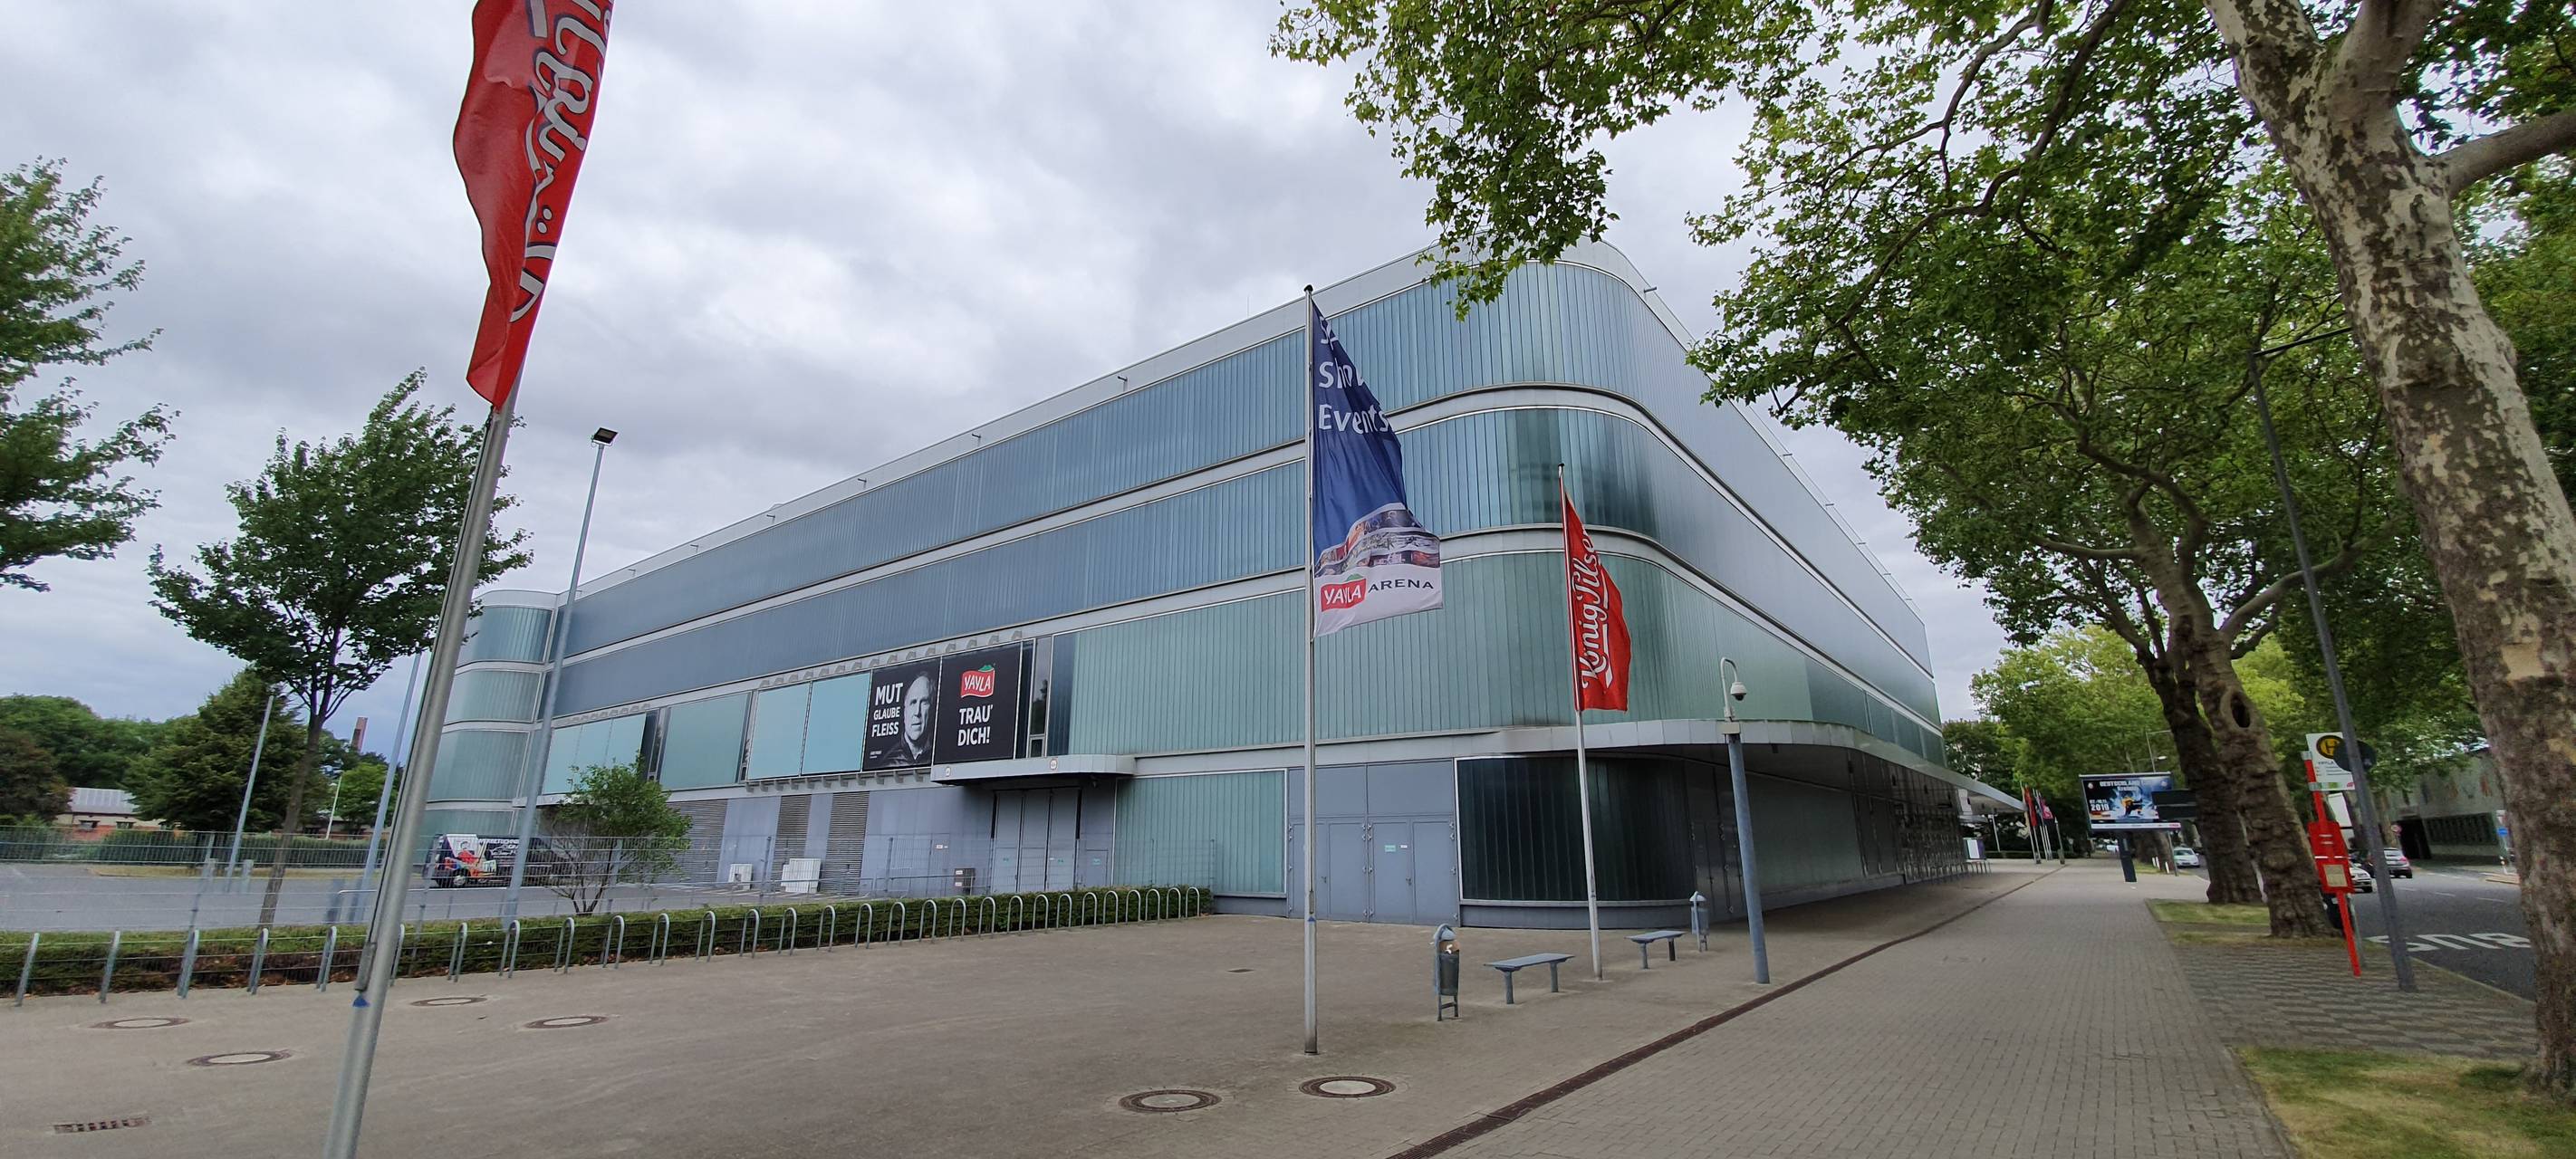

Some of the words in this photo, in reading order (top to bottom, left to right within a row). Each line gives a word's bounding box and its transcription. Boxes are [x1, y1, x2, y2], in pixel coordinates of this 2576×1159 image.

[1319, 404, 1389, 434] Events
[1323, 585, 1361, 605] YAYLA
[1368, 579, 1434, 593] ARENA
[964, 675, 991, 692] YAYLA
[874, 683, 904, 705] MUT
[873, 707, 900, 720] GLAUBE
[871, 722, 899, 737] FLEISS
[957, 726, 991, 746] DICH!
[2365, 933, 2533, 952] BUS
